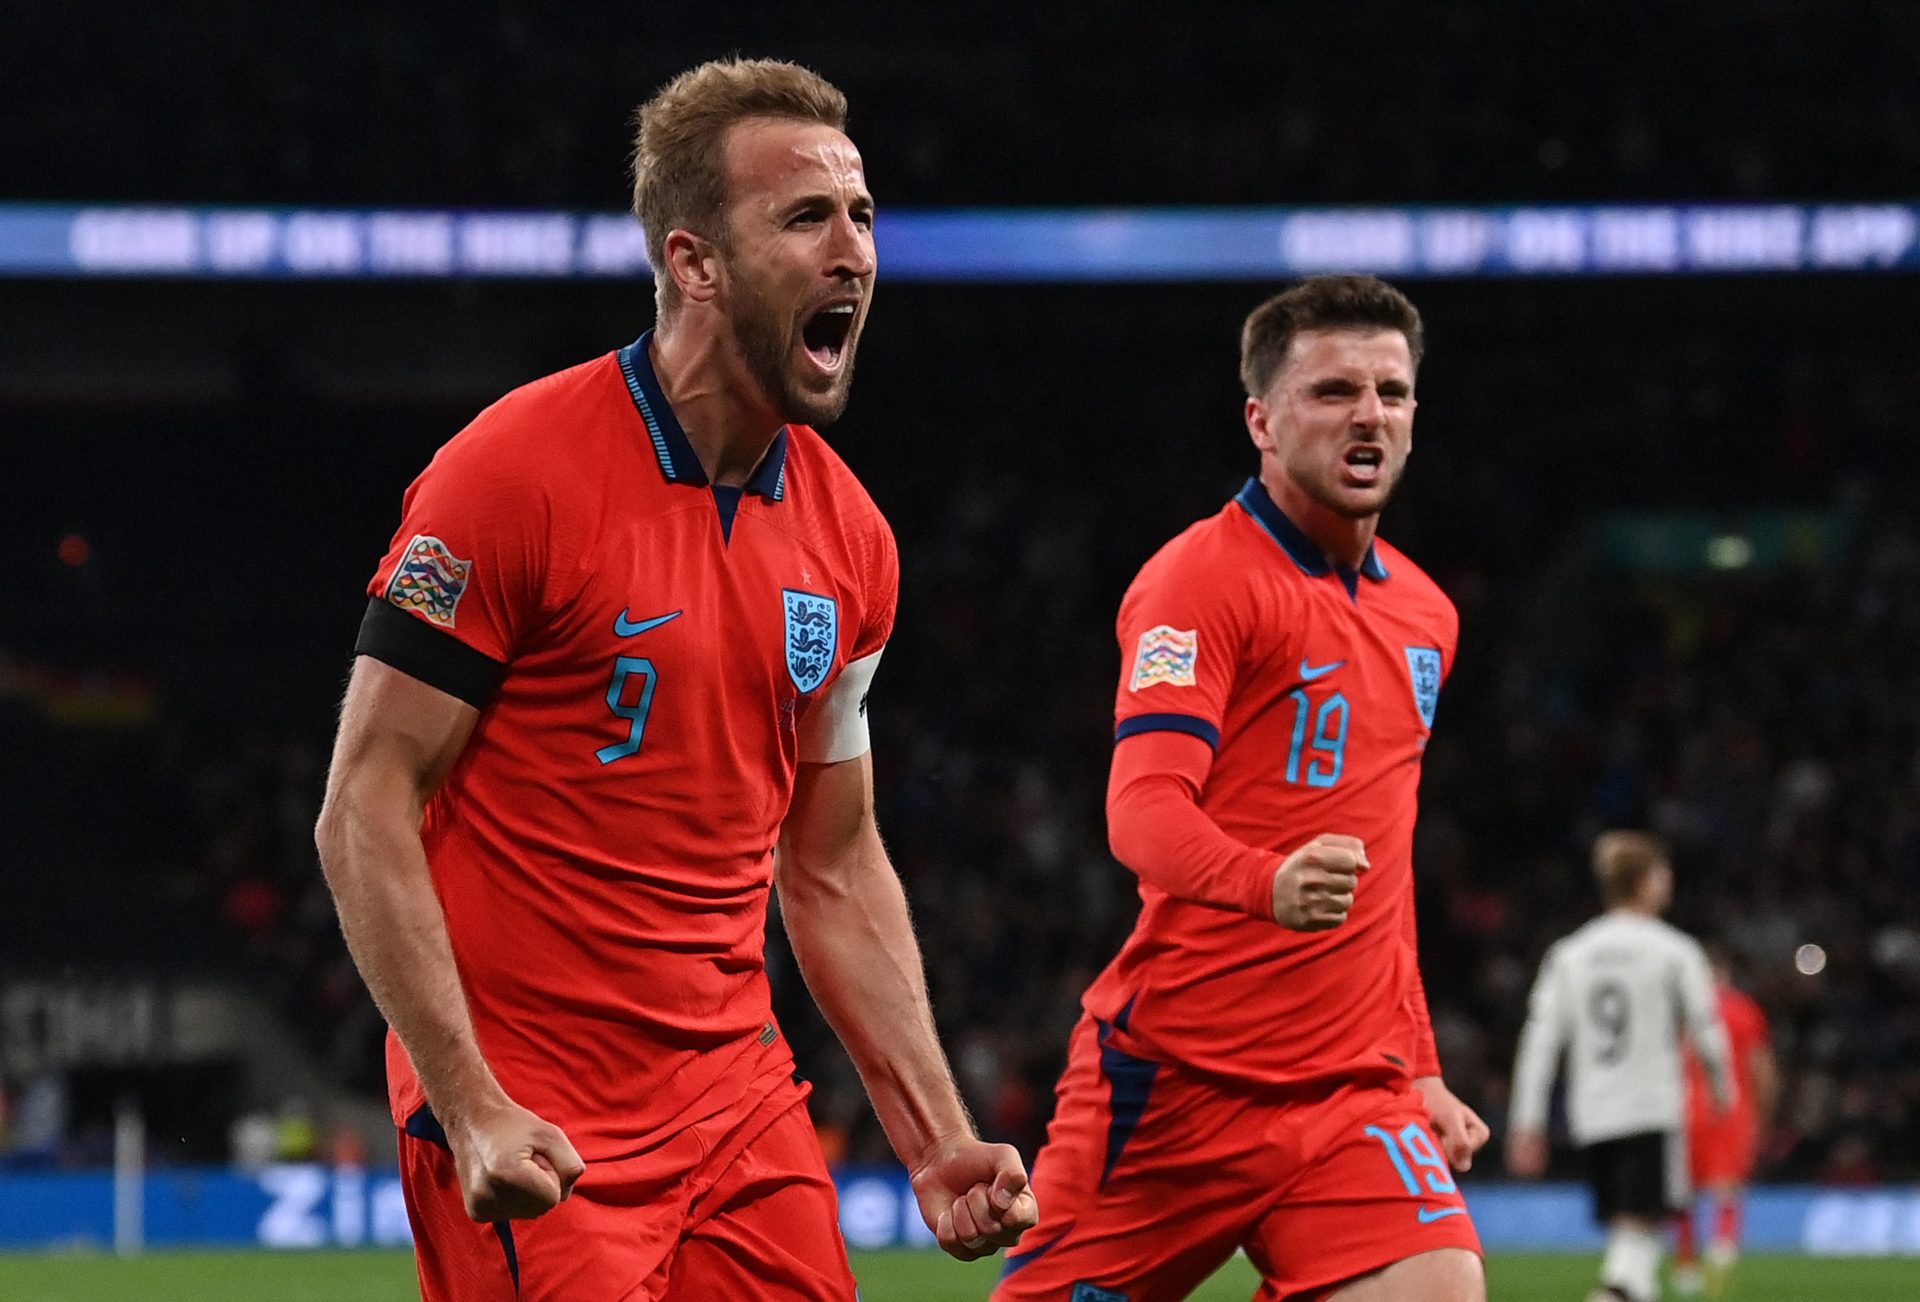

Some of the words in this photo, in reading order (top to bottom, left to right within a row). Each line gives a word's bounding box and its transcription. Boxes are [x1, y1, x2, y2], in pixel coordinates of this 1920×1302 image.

[595, 655, 658, 766] 9
[1286, 687, 1350, 788] 19
[1586, 978, 1633, 1068] 9
[1363, 1122, 1457, 1196] 19
